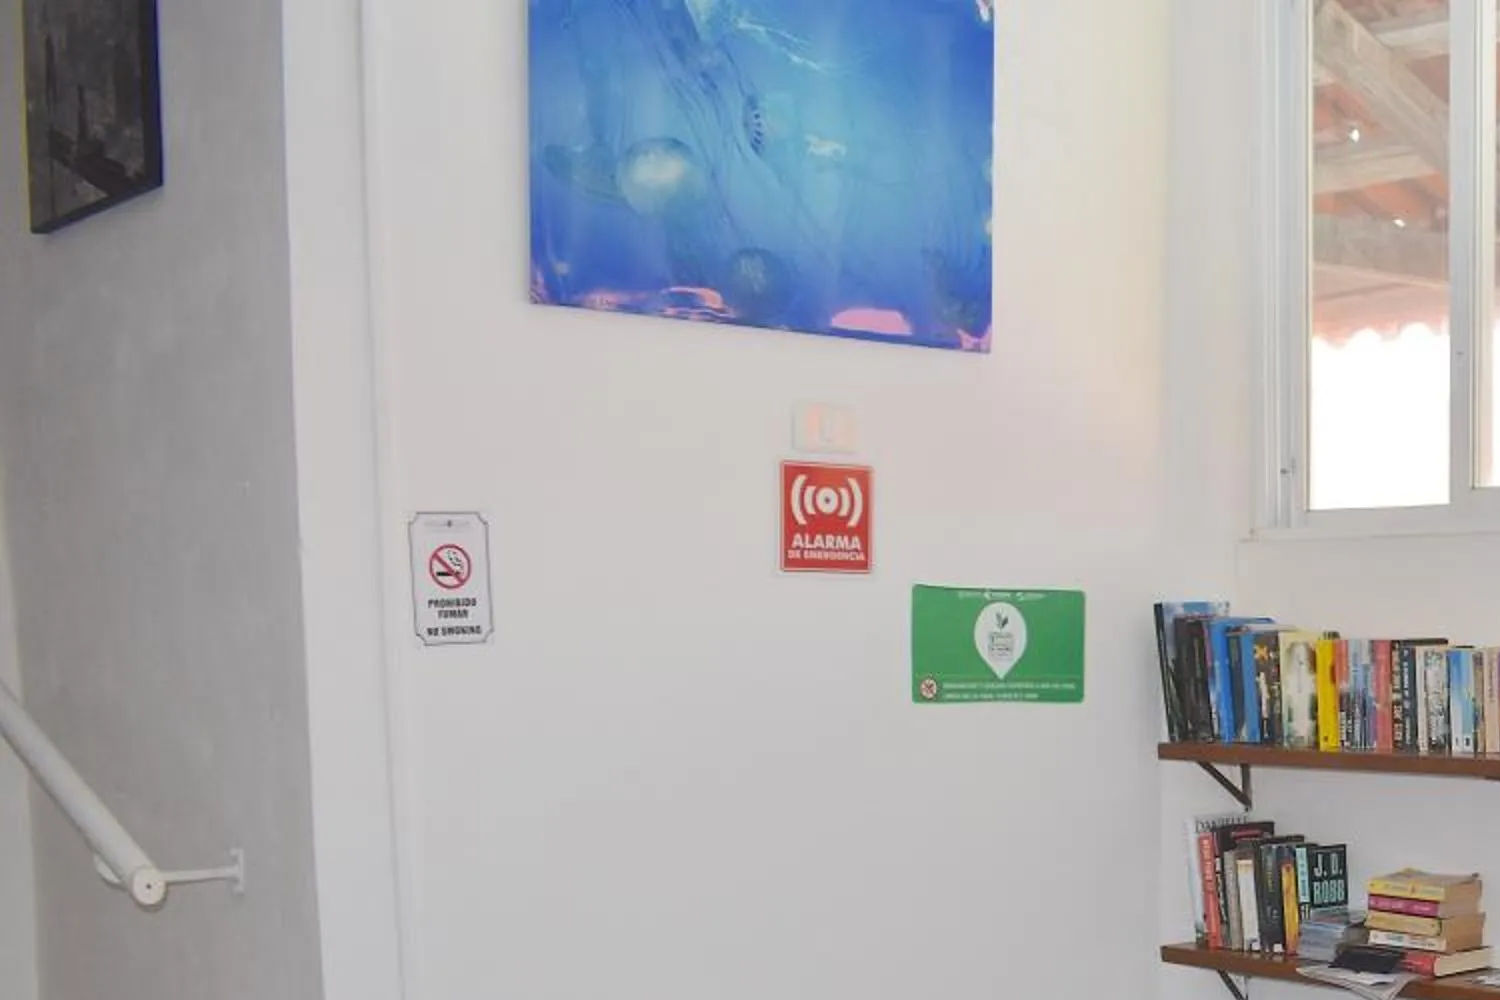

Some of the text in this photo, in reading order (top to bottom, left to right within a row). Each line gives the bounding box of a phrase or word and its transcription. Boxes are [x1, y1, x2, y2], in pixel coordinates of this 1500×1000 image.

[791, 533, 861, 551] ALARMA
[787, 549, 866, 561] DE EMERGENCIA
[427, 597, 477, 609] PROHIBIDO
[437, 608, 469, 619] FUMAR
[426, 625, 483, 637] NO SMOKING
[1313, 853, 1328, 877] J.
[1313, 879, 1345, 904] ROBB
